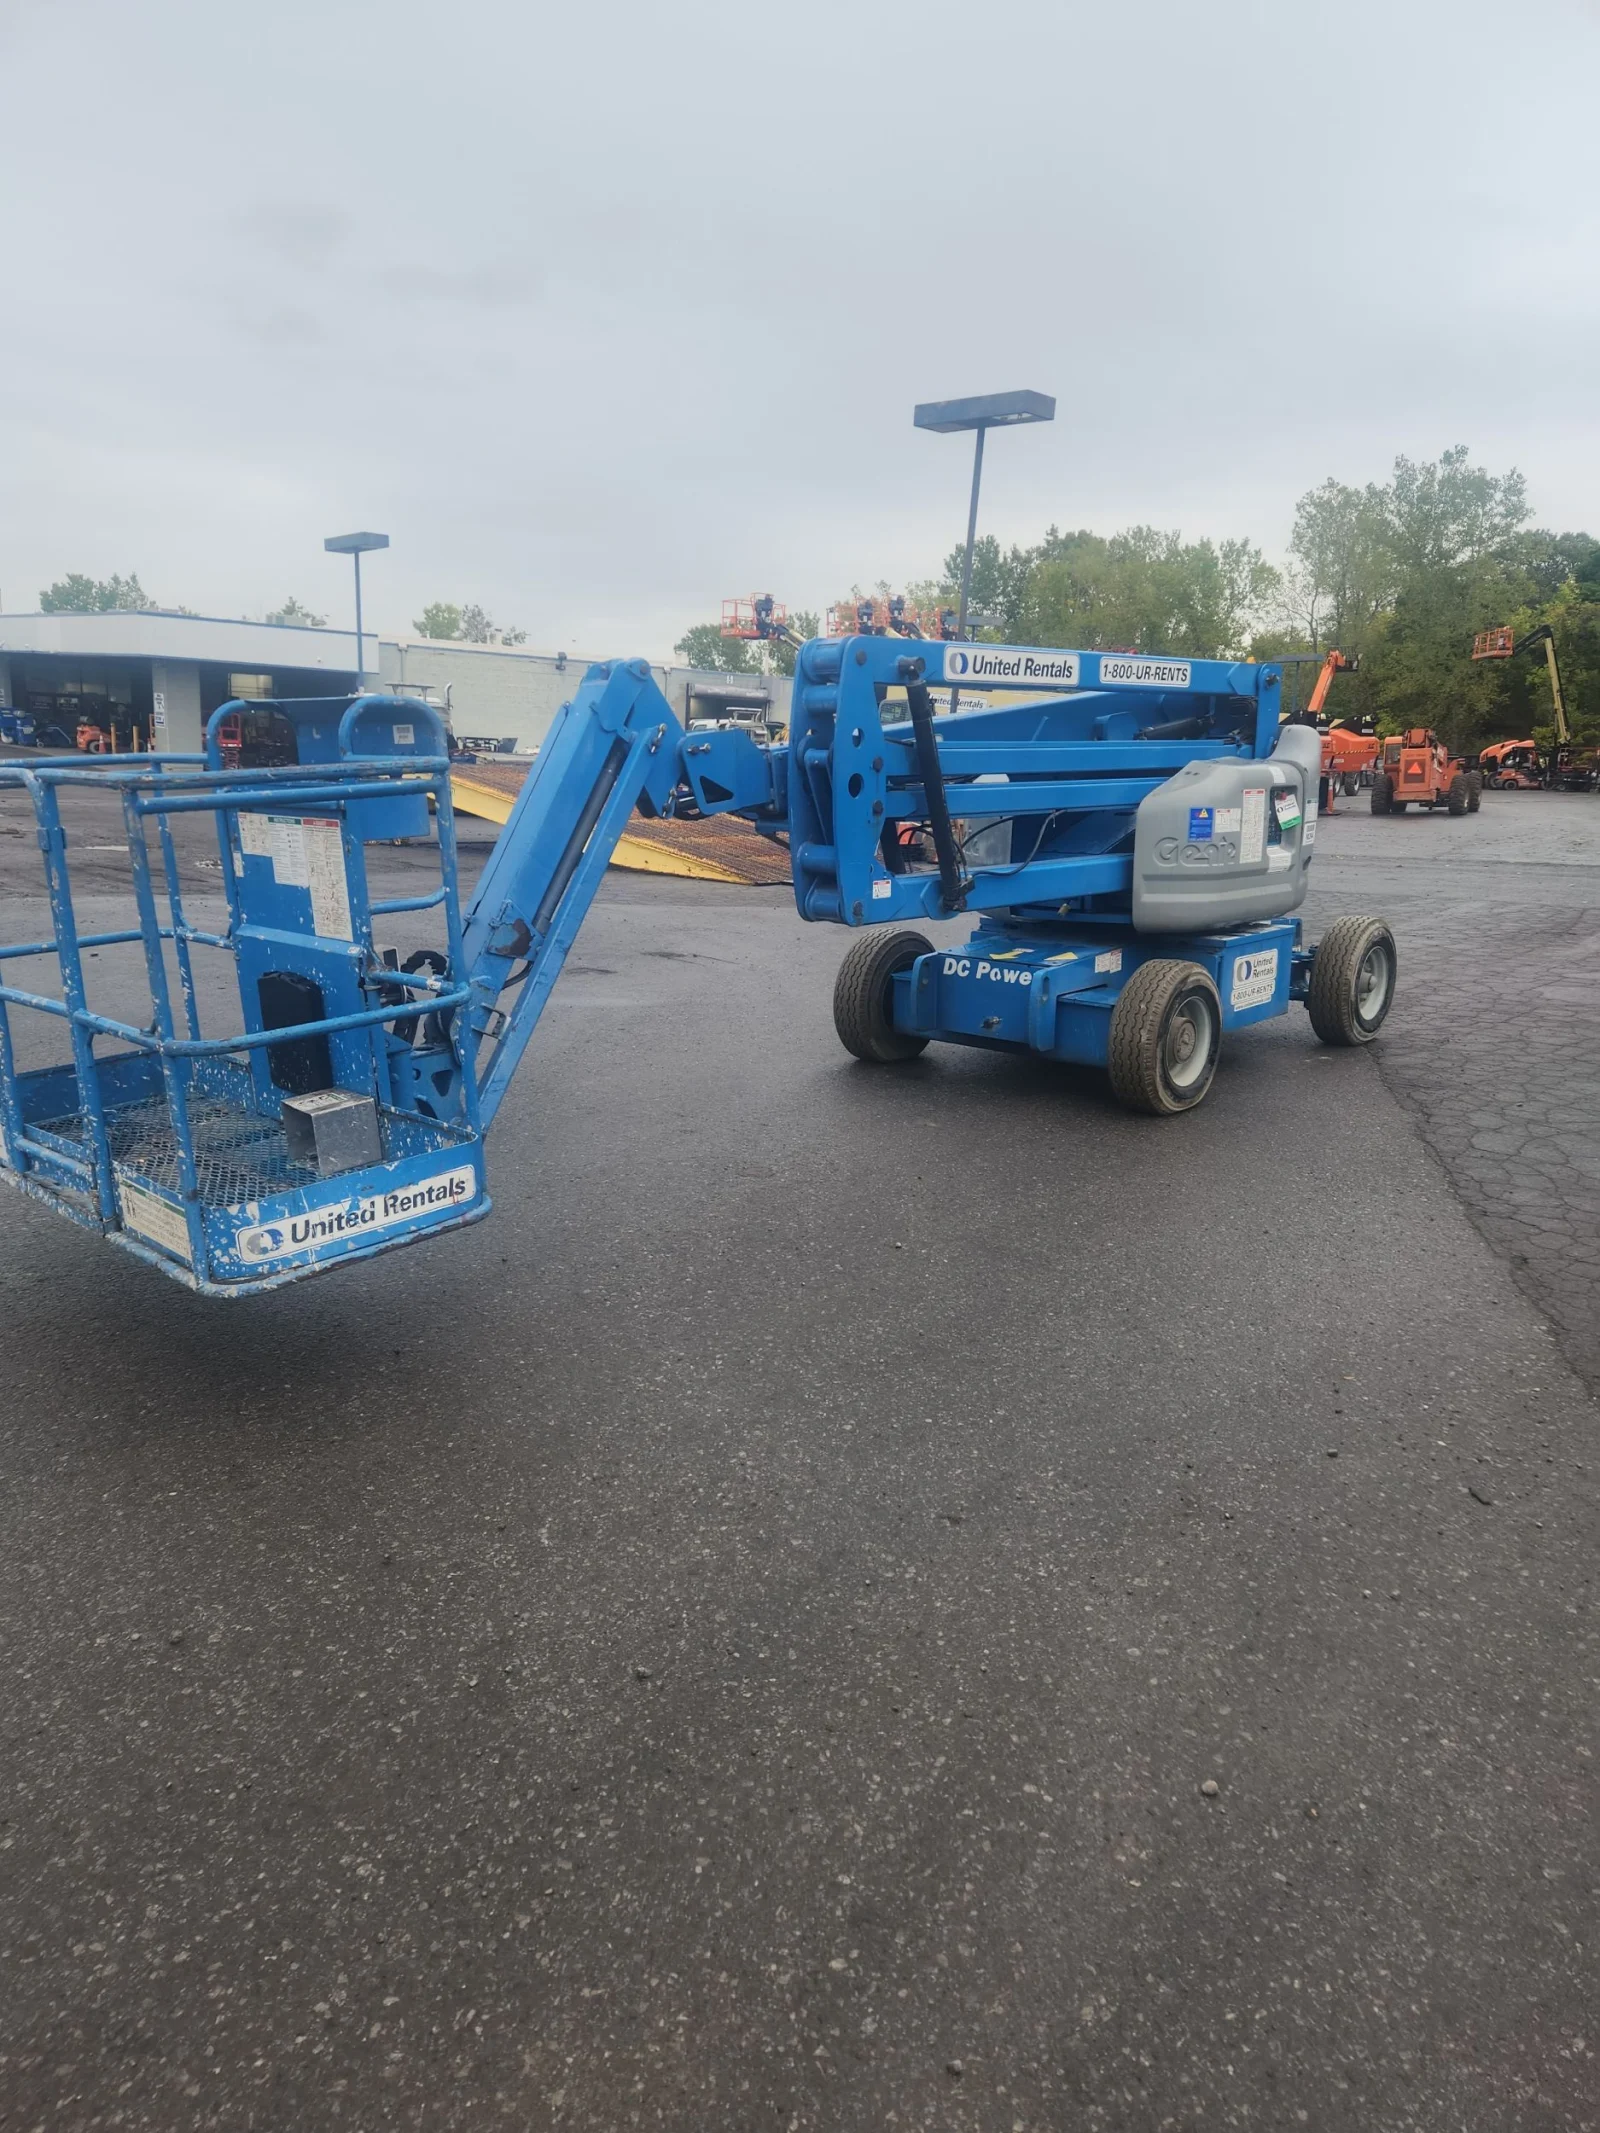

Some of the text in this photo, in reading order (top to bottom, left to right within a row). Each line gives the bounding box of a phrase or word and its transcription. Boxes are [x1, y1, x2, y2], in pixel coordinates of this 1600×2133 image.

[972, 654, 1074, 680] United Rentals
[1102, 663, 1189, 683] 1-800-UR-RENTS
[1152, 836, 1237, 868] Genie
[943, 957, 1033, 986] DC Powe
[1252, 967, 1275, 979] Rentals
[1253, 955, 1275, 968] United
[290, 1177, 467, 1244] United Rentals
